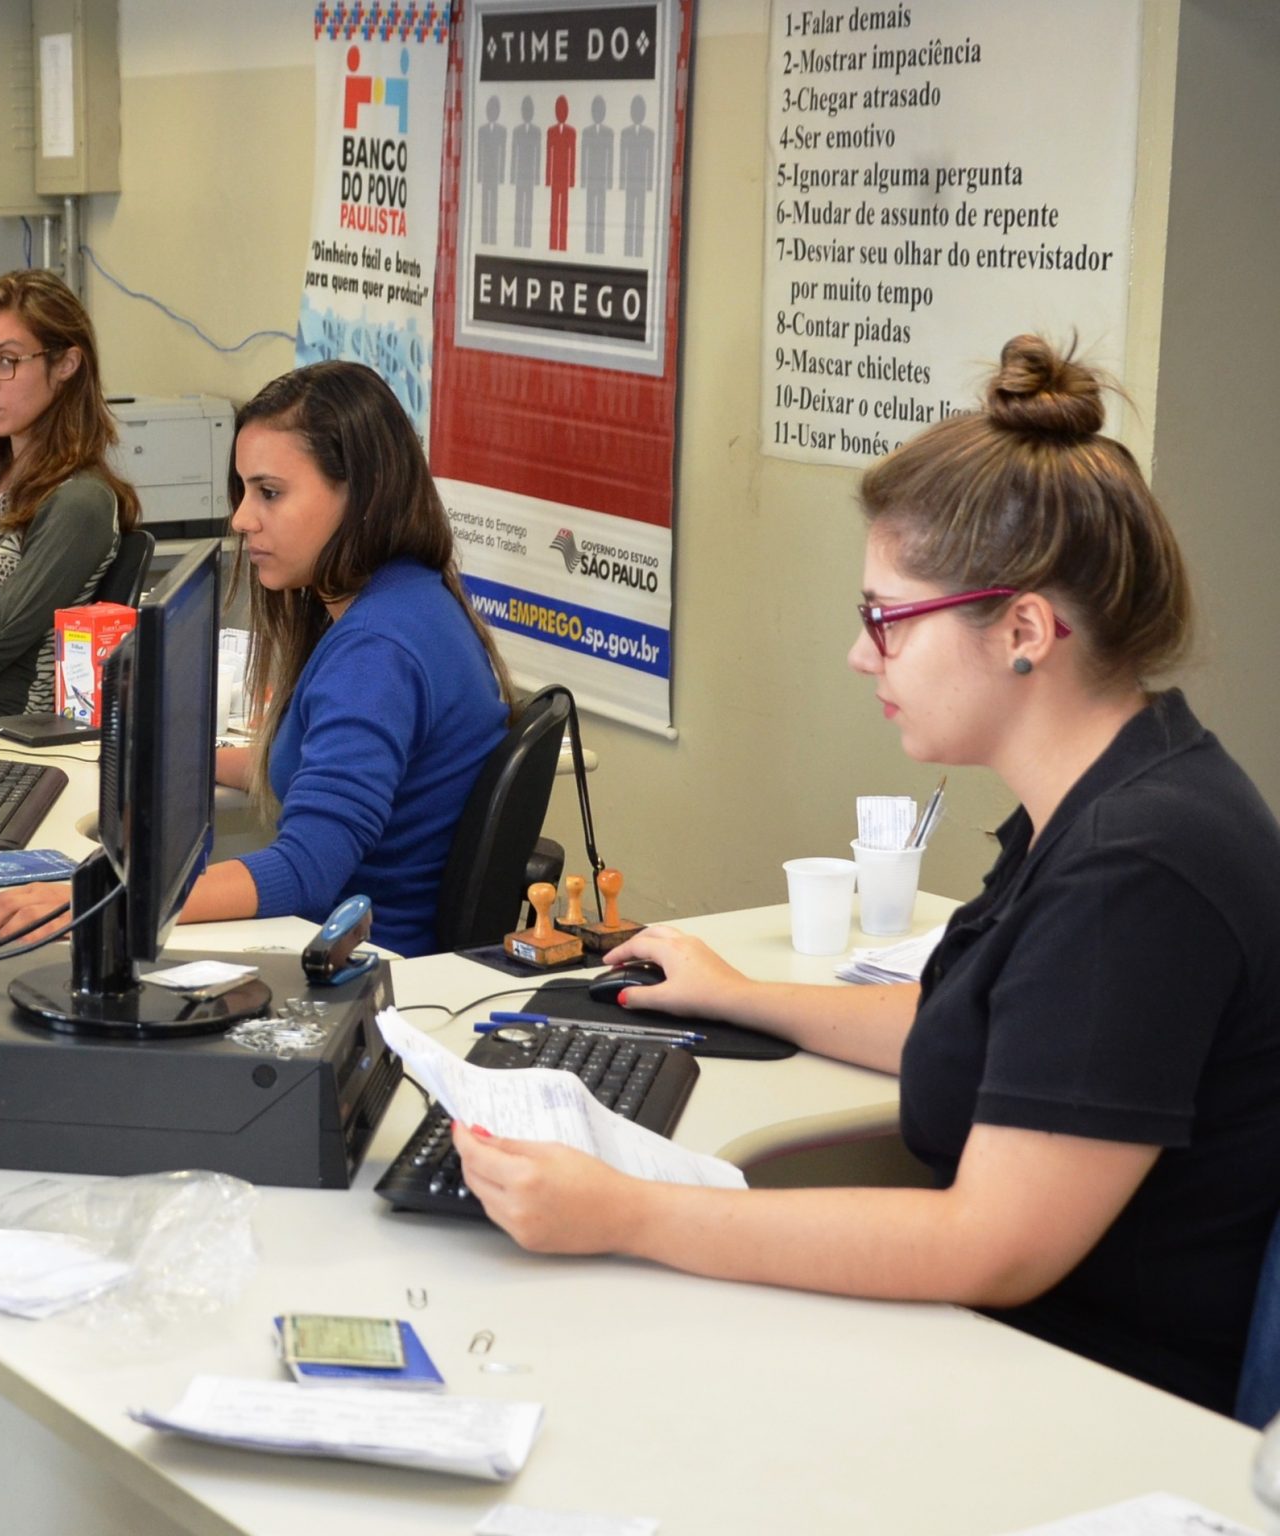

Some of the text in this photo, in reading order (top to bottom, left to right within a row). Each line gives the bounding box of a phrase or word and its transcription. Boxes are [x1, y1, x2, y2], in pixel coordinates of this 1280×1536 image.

[785, 2, 911, 37] 1-Falar demais
[501, 26, 630, 63] TIME DO
[783, 37, 982, 76] 2-Mostrar impaciência
[782, 81, 941, 117] 3-Chegar atrasado
[342, 135, 408, 172] BANCO
[779, 122, 895, 150] 4-Ser emotivo
[341, 169, 408, 208] DO POVO
[777, 161, 1023, 194] 5-Ignorar alguma pergunta
[340, 203, 407, 237] PAULISTA
[776, 199, 1059, 235] 6-Mudar de assunto de repente
[384, 256, 392, 272] e
[395, 250, 421, 278] barato
[776, 238, 1113, 272] 7-Desviar seu olhar do entrevistador
[332, 274, 359, 294] quem
[362, 279, 384, 299] quer
[480, 274, 641, 321] EMPREGO
[790, 278, 933, 311] por muito tempo
[776, 311, 911, 346] 8-Contar piadas
[775, 348, 930, 385] 9-Mascar chicletes
[775, 384, 854, 416] 10-Deixar
[858, 399, 868, 417] o
[874, 396, 934, 424] celular
[774, 421, 889, 456] 11-Usar bonés
[485, 518, 495, 529] do
[496, 518, 527, 539] Emprego
[486, 535, 495, 547] do
[497, 536, 527, 556] Trabalho
[581, 540, 659, 568] GOVERNO DO ESTADO
[580, 553, 658, 593] SÃO PAULO
[471, 593, 660, 663] www.EMPREGO.sp.gov.br
